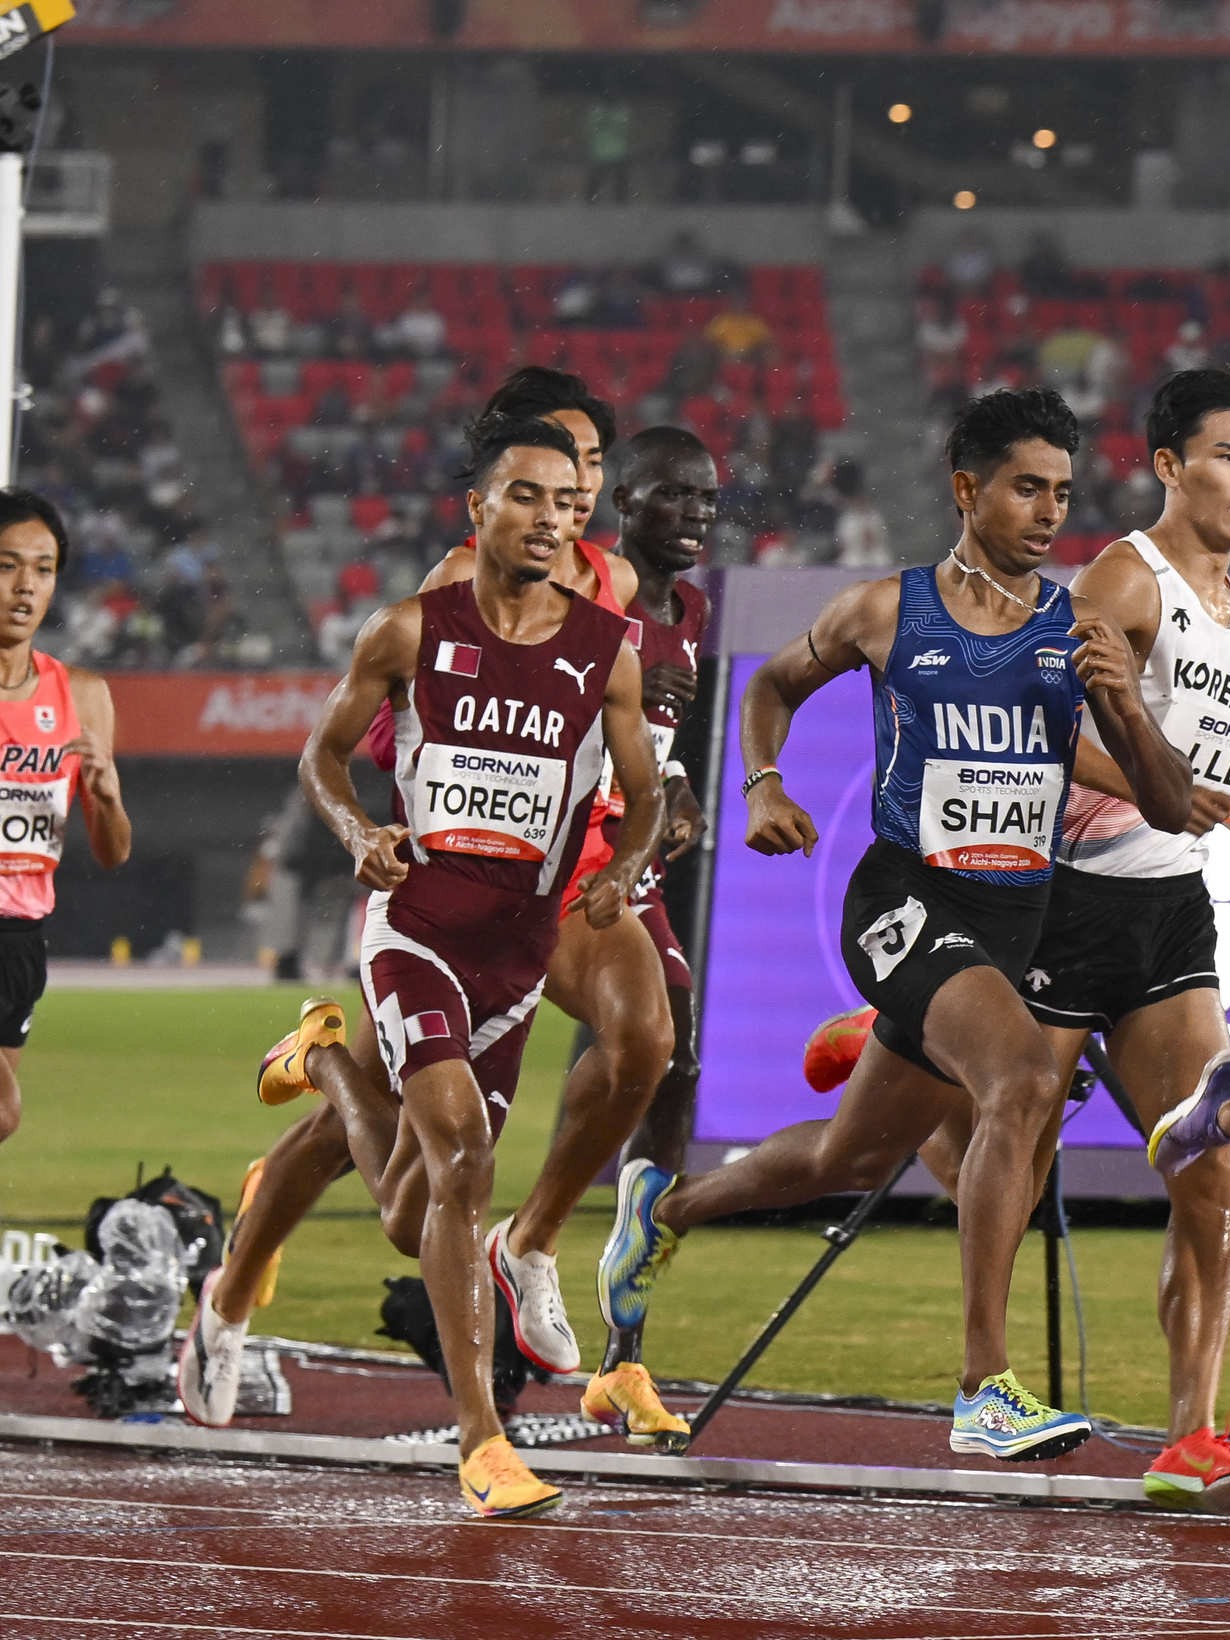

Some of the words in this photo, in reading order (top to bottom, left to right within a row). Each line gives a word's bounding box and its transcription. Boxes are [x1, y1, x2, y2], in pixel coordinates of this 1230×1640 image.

[906, 655, 951, 670] JSW
[1036, 657, 1067, 670] INDIA
[454, 695, 565, 748] QATAR
[933, 702, 1049, 754] INDIA
[450, 754, 540, 778] BORNAN
[957, 768, 1044, 786] BORNAN
[426, 781, 552, 826] TORECH
[940, 798, 1046, 834] SHAH
[523, 829, 547, 840] 639
[1033, 835, 1047, 848] 319
